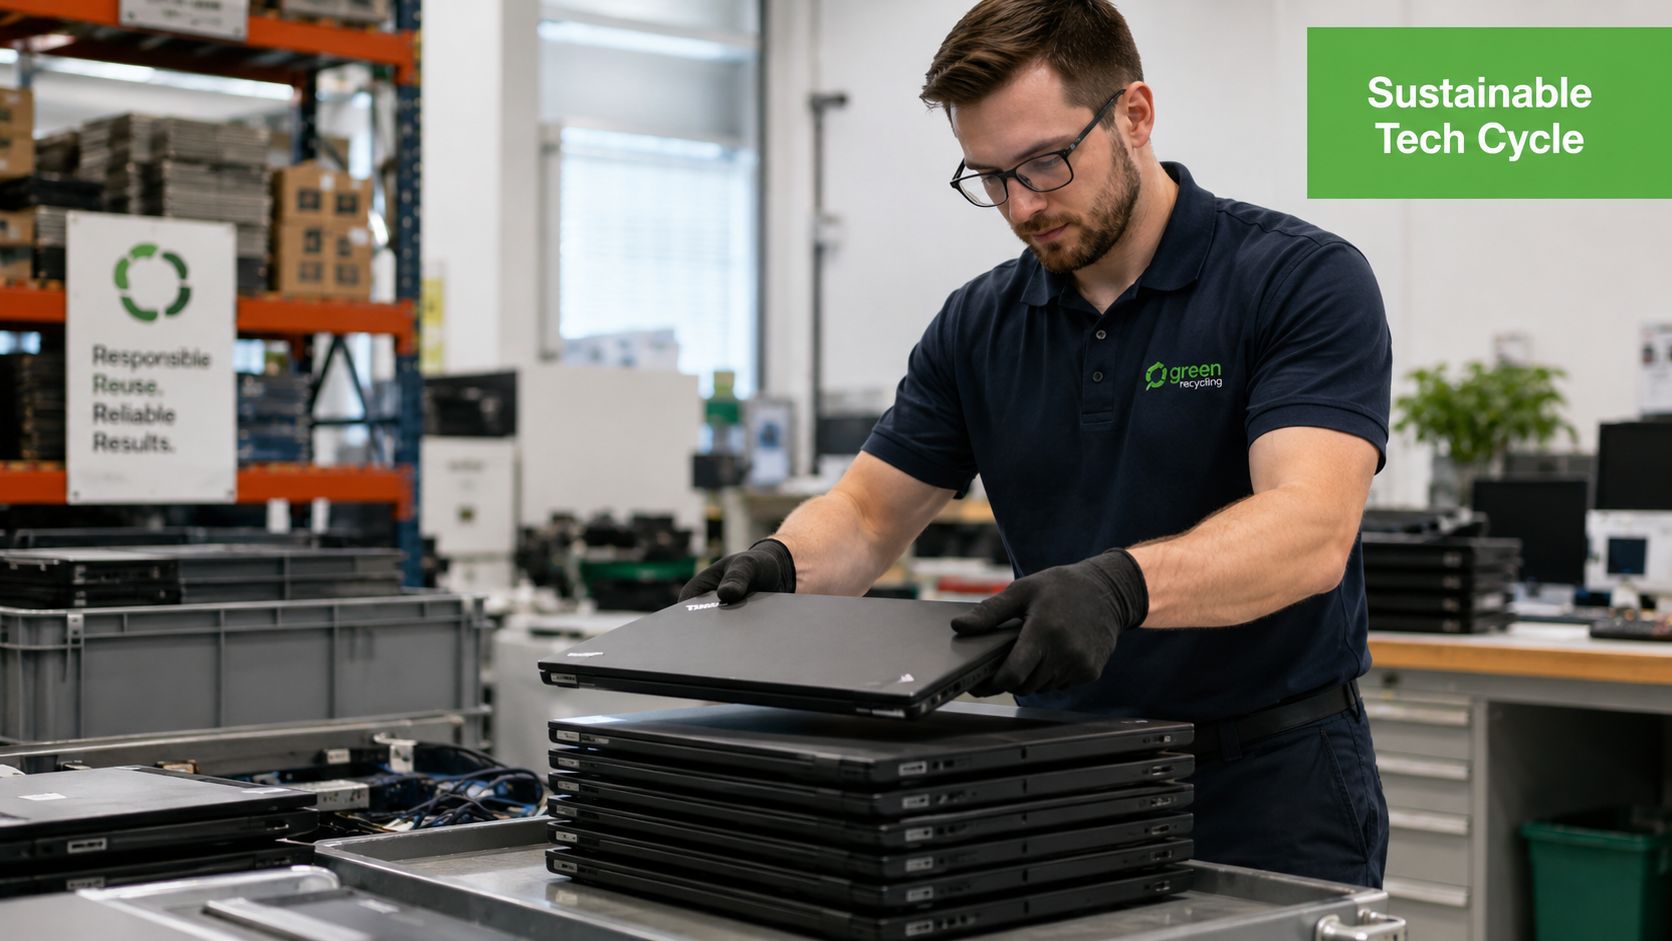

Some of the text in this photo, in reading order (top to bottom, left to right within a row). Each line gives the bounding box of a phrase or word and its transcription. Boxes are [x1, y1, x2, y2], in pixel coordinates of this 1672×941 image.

[92, 345, 211, 371] Responsible
[92, 373, 164, 395] Reuse.
[1169, 363, 1221, 384] green
[1180, 378, 1222, 390] recycling
[92, 402, 176, 424] Reliable
[92, 431, 176, 453] Results.
